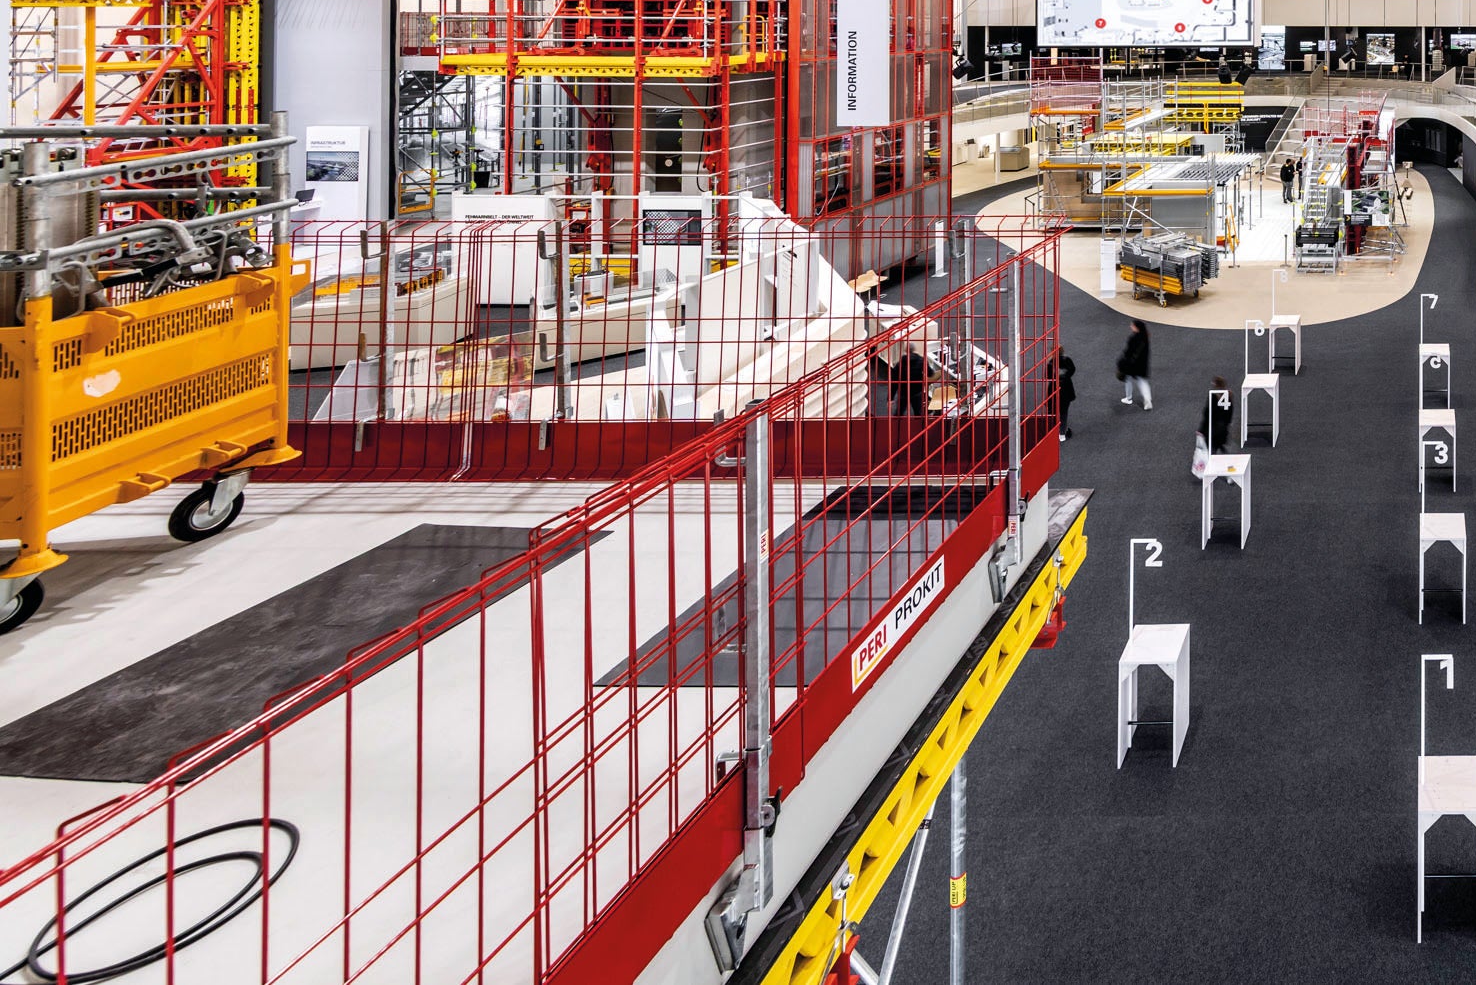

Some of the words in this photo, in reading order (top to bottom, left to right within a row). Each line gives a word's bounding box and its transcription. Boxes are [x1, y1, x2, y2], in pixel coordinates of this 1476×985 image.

[848, 31, 857, 111] INFORMATION
[1428, 295, 1438, 309] 7
[1254, 321, 1265, 336] 6
[1217, 390, 1231, 410] 4
[1434, 443, 1448, 464] 3
[1145, 541, 1163, 567] 2
[859, 624, 887, 671] PERI
[895, 563, 942, 630] PROKIT
[1440, 655, 1454, 689] 1
